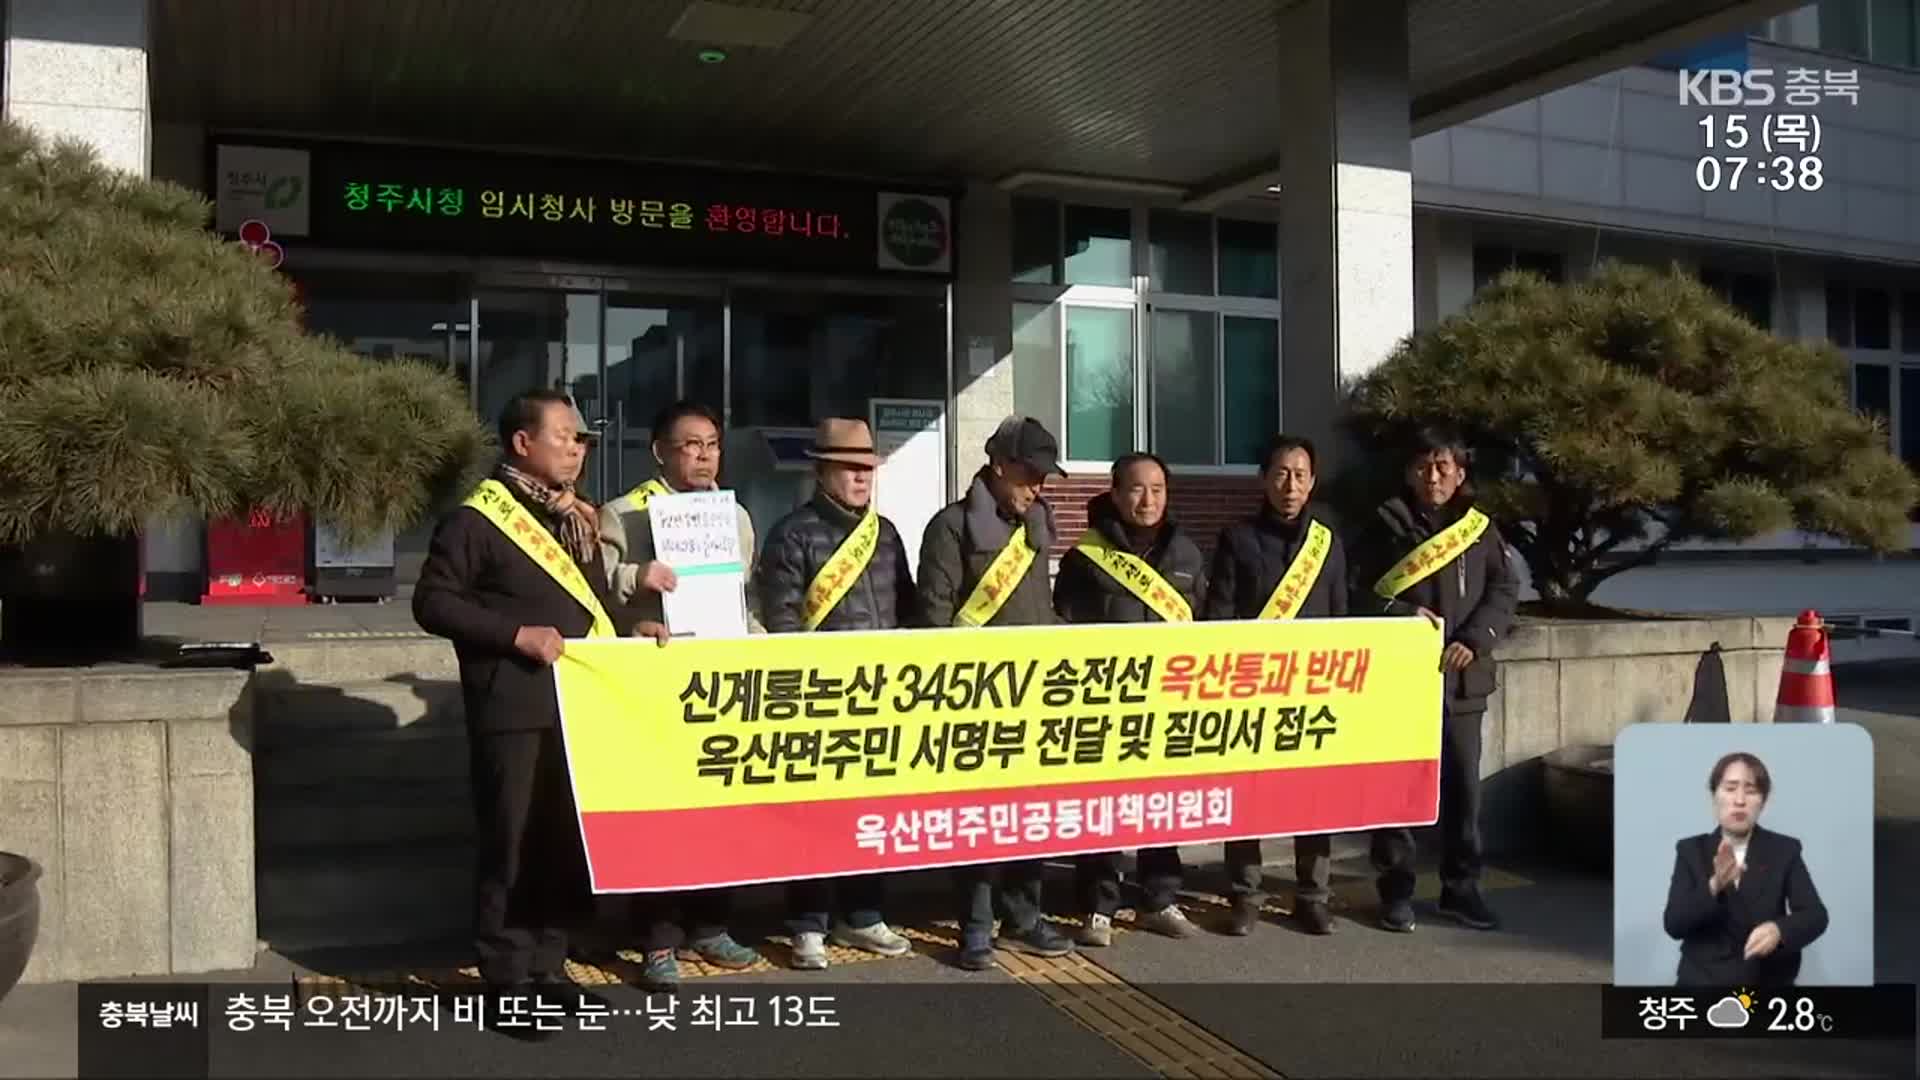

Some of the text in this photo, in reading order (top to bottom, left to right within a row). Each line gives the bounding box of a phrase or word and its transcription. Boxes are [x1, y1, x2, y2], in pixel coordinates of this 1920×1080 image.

[343, 182, 464, 216] 청주시청
[480, 189, 597, 223] 임시청사
[610, 198, 693, 230] 방문을
[704, 202, 849, 239] 환영합니다.
[679, 648, 1372, 724] 신계룡논산 345KV 송전선 옥산통과 반대
[697, 704, 1338, 787] 옥산면주민 서명부 전달 및 질의서 접수
[855, 787, 1233, 855] 옥산면주민공동대책위원회
